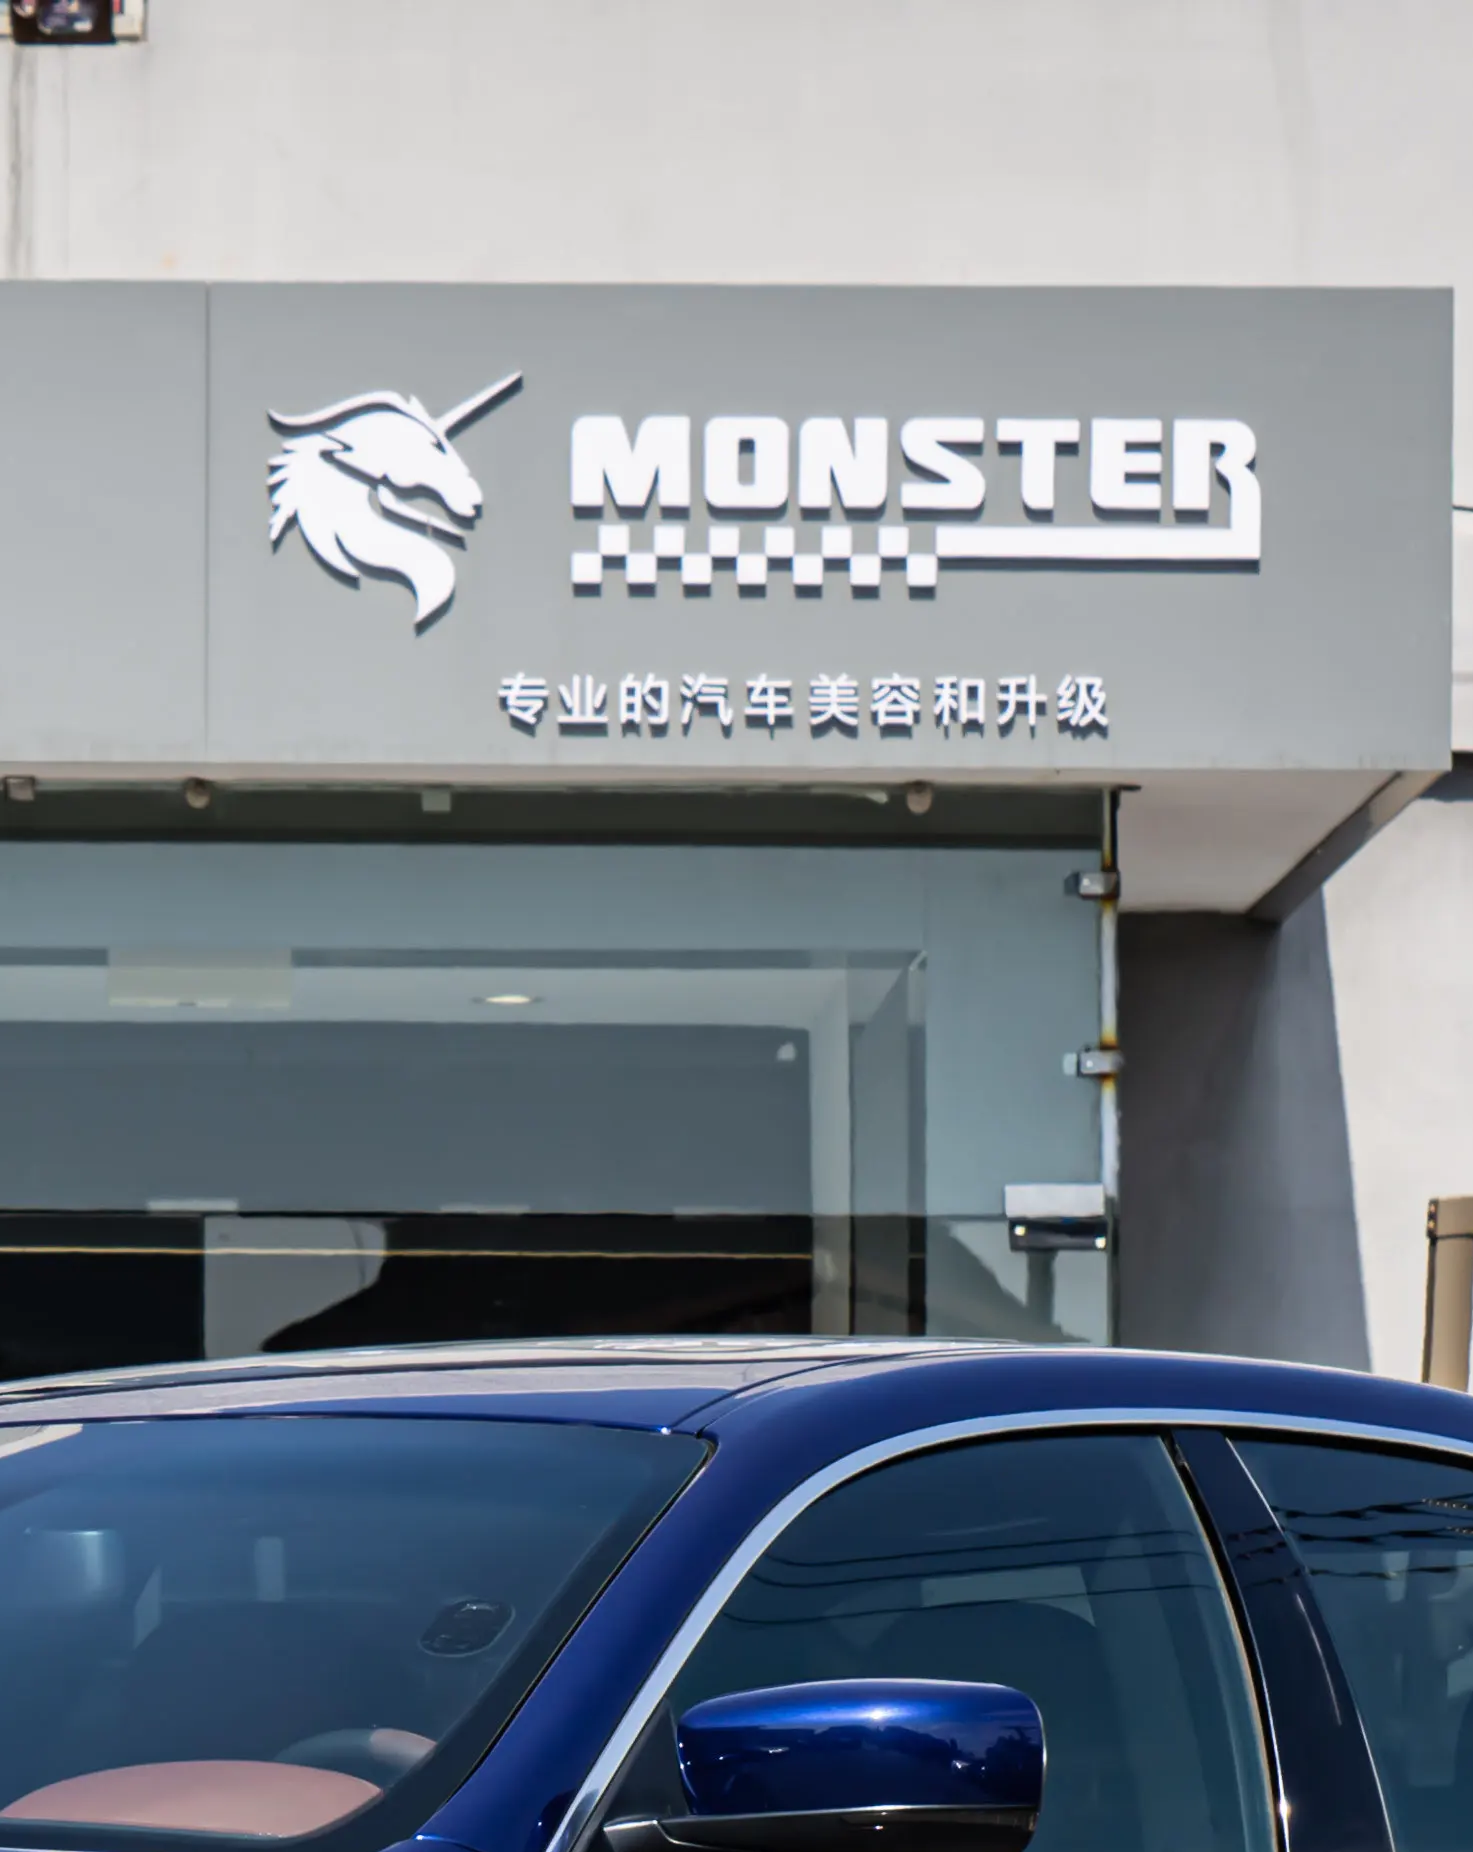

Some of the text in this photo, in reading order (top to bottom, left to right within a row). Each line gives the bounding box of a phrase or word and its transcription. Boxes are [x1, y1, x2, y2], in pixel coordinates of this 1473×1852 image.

[571, 415, 1260, 513] MONSTER
[497, 671, 1108, 726] 专业的汽车美容和升级
